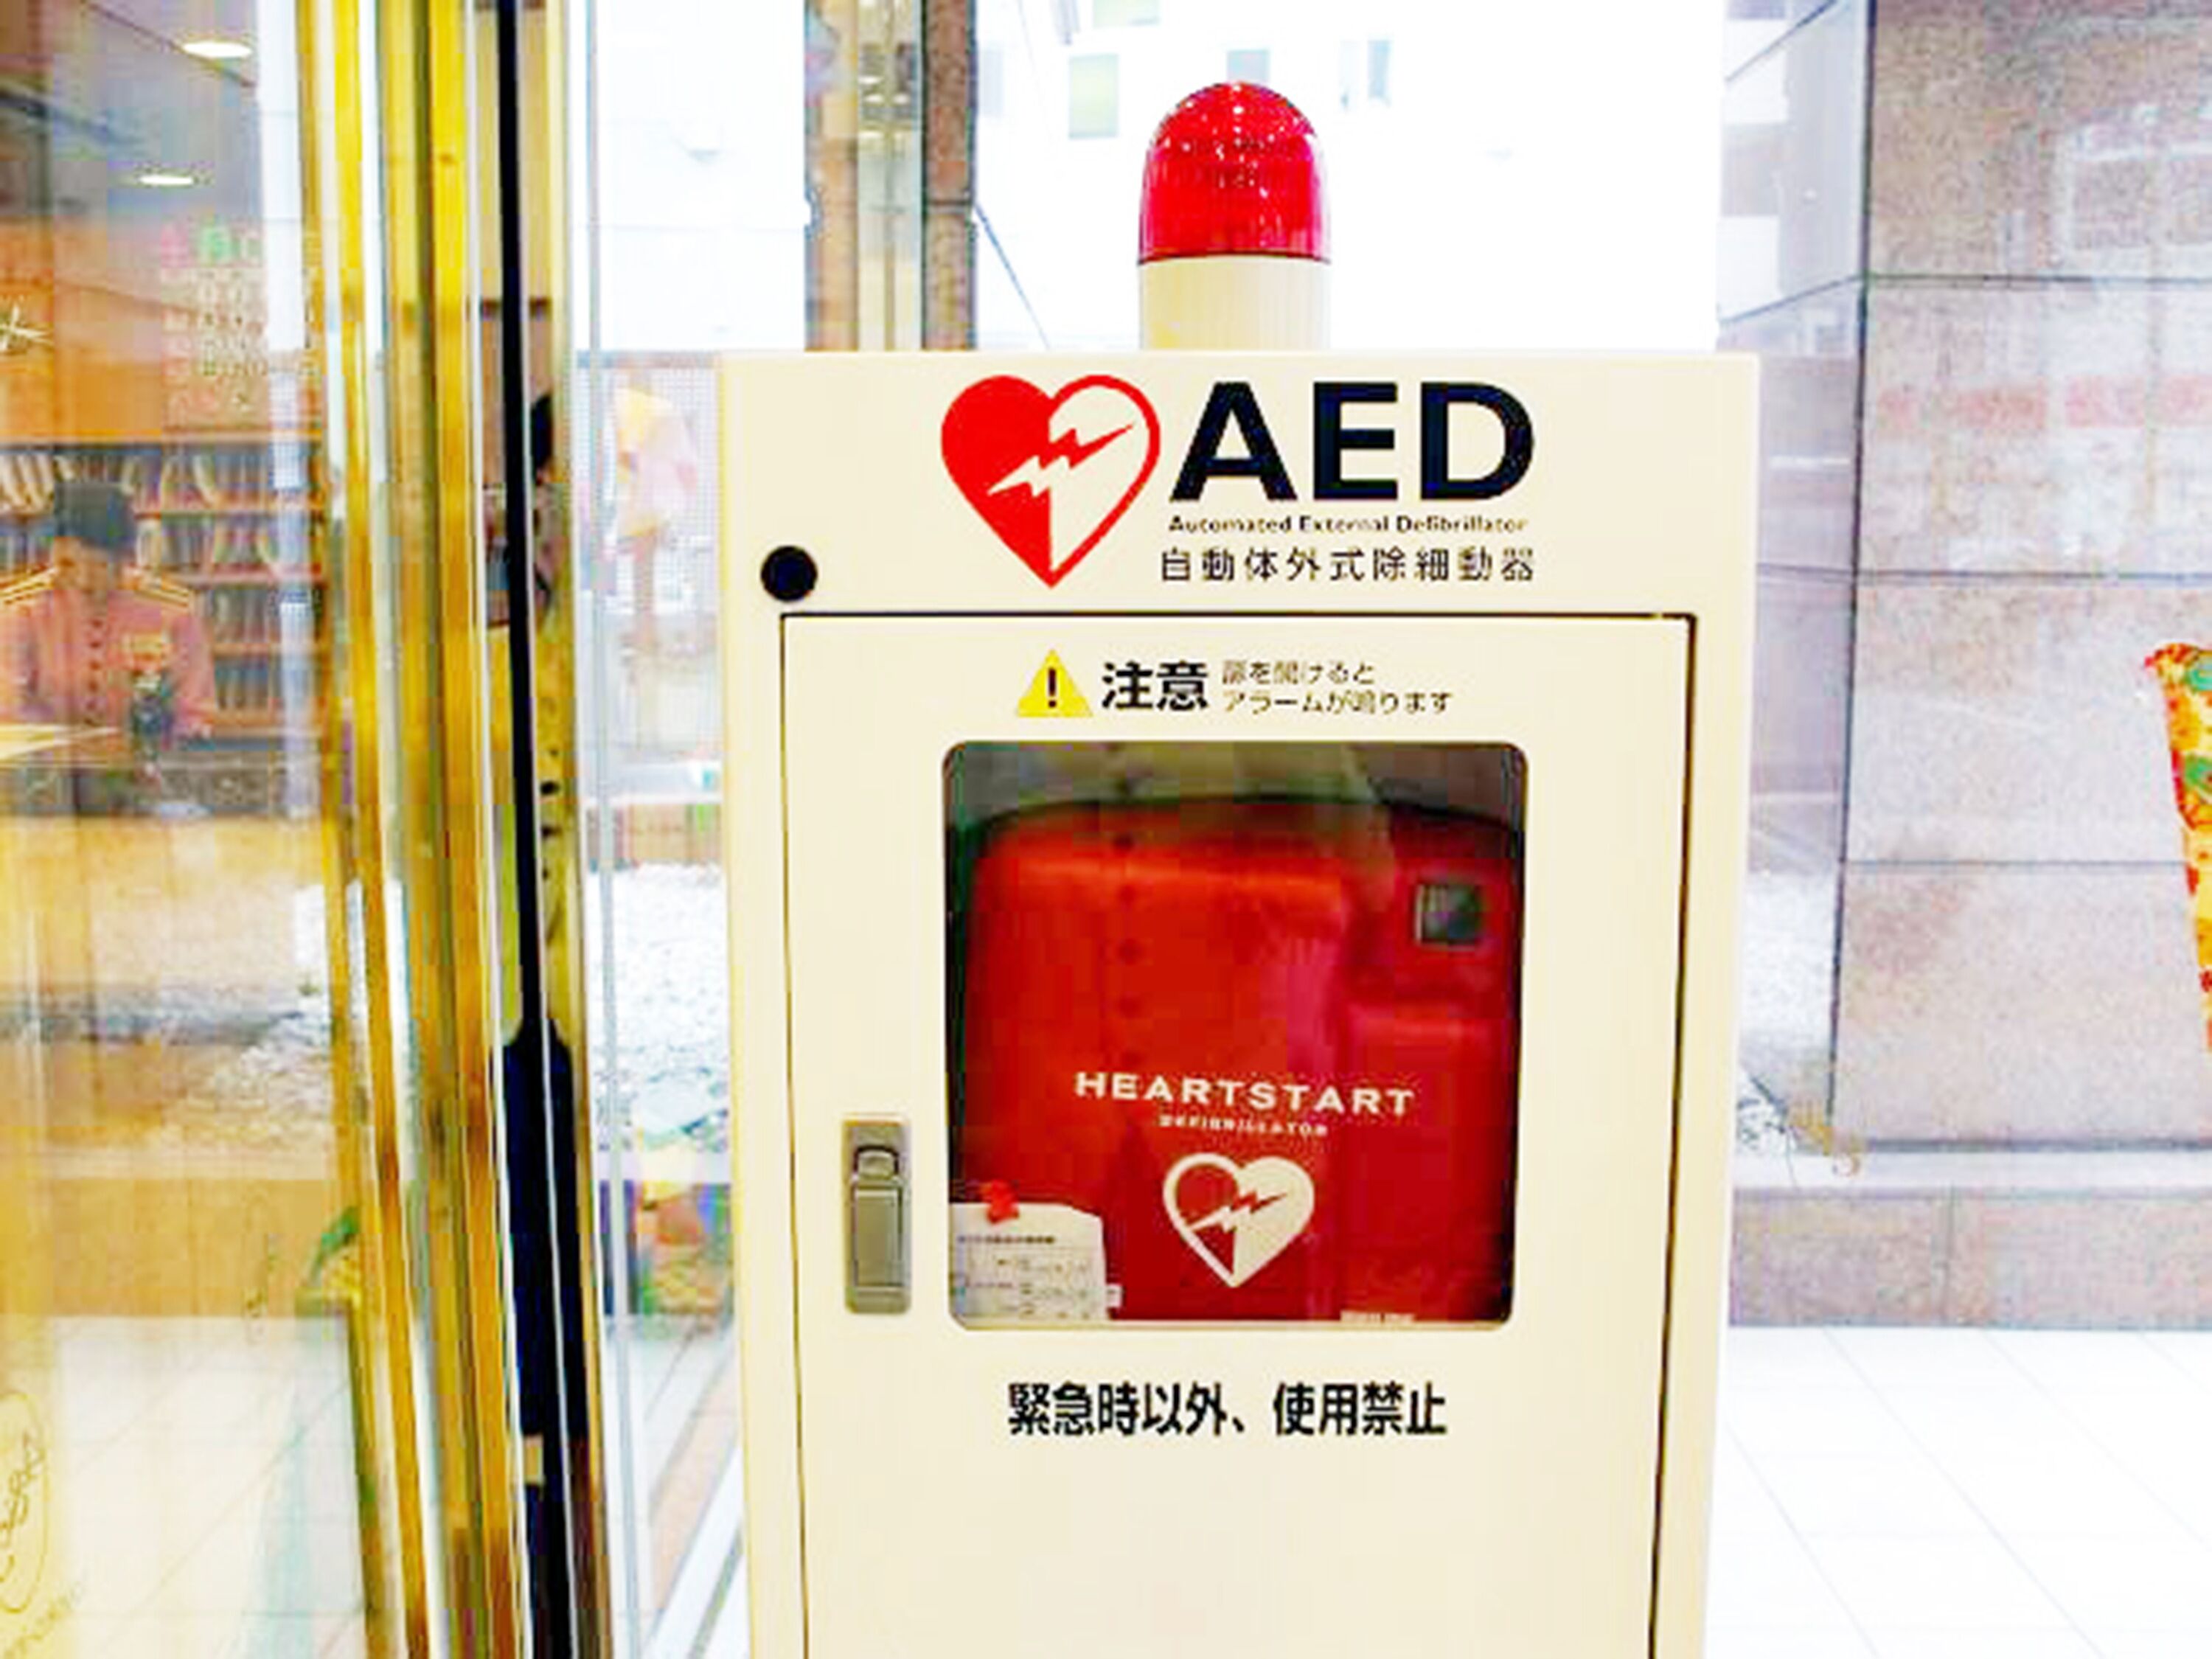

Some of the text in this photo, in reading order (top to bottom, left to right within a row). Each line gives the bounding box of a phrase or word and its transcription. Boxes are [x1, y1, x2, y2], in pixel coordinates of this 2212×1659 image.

[1169, 381, 1534, 502] AED
[1169, 515, 1528, 534] Automated External Defibrillator
[1161, 546, 1534, 582] 自動体外式除細動器
[1101, 660, 1209, 712] 注意
[1075, 1071, 1415, 1116] HEARTSTART
[1007, 1380, 1448, 1438] 緊急時以外、使用禁止
